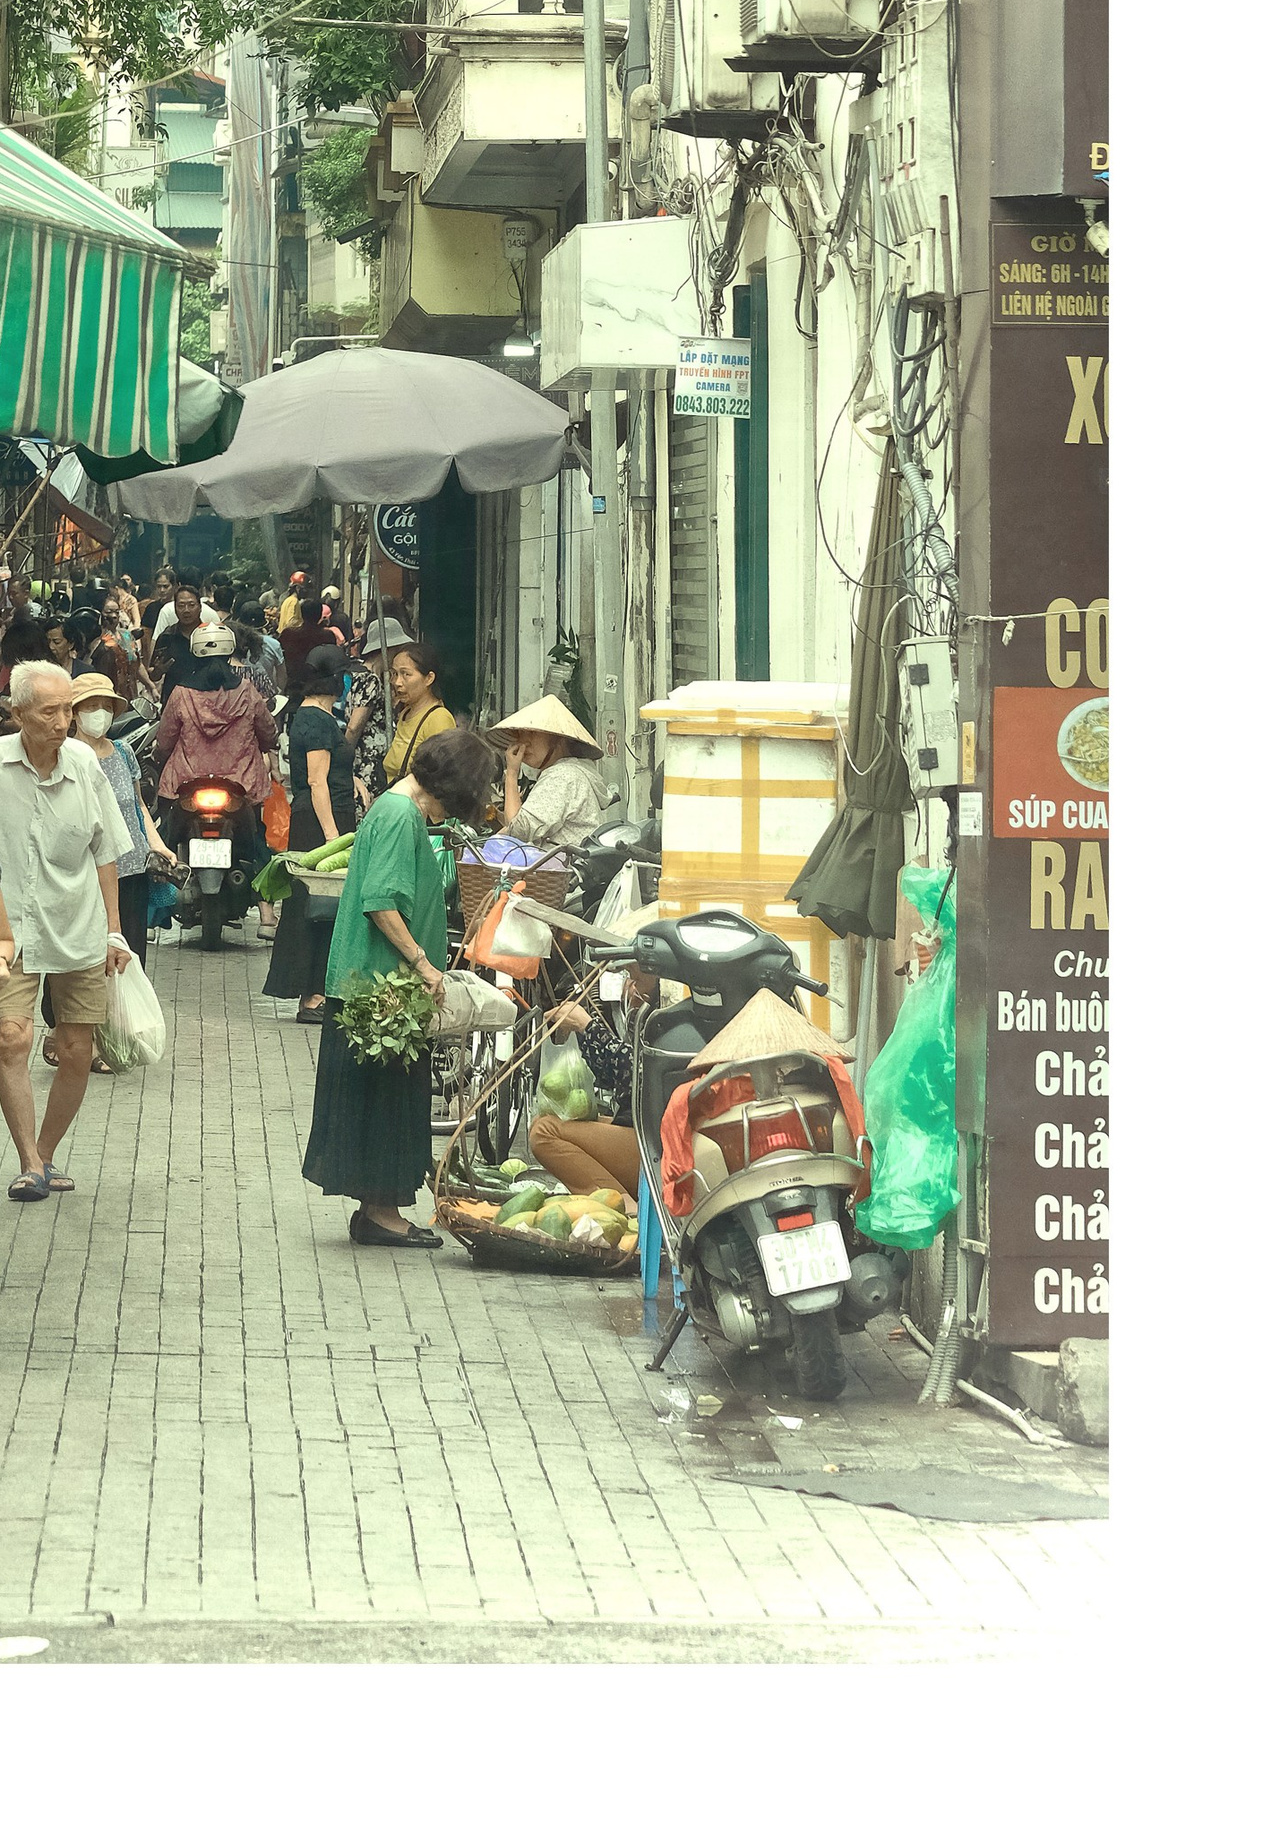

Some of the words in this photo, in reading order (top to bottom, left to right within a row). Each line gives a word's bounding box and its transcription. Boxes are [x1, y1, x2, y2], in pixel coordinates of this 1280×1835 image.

[506, 227, 526, 236] P755
[1031, 231, 1077, 253] GIỜ
[999, 259, 1047, 283] SÁNG:
[1051, 264, 1071, 284] 6H
[1001, 290, 1032, 316] LIÊN
[1035, 290, 1053, 321] HỆ
[1056, 291, 1098, 317] NGOÀI
[721, 355, 750, 367] MẠNG
[696, 381, 731, 392] CAMERA
[712, 368, 732, 379] HÌNH
[734, 370, 750, 380] FPT
[675, 395, 750, 416] 0843.803.222
[1065, 356, 1109, 445] X
[382, 506, 417, 529] Cắt
[393, 532, 417, 547] GỘI
[1008, 795, 1057, 829] SÚP
[1062, 800, 1109, 830] CUA
[997, 990, 1047, 1033] Bán
[1035, 1045, 1109, 1097] Chả
[1034, 1117, 1109, 1169] Chả
[1034, 1189, 1109, 1241] Chả
[1034, 1262, 1109, 1315] Chả
